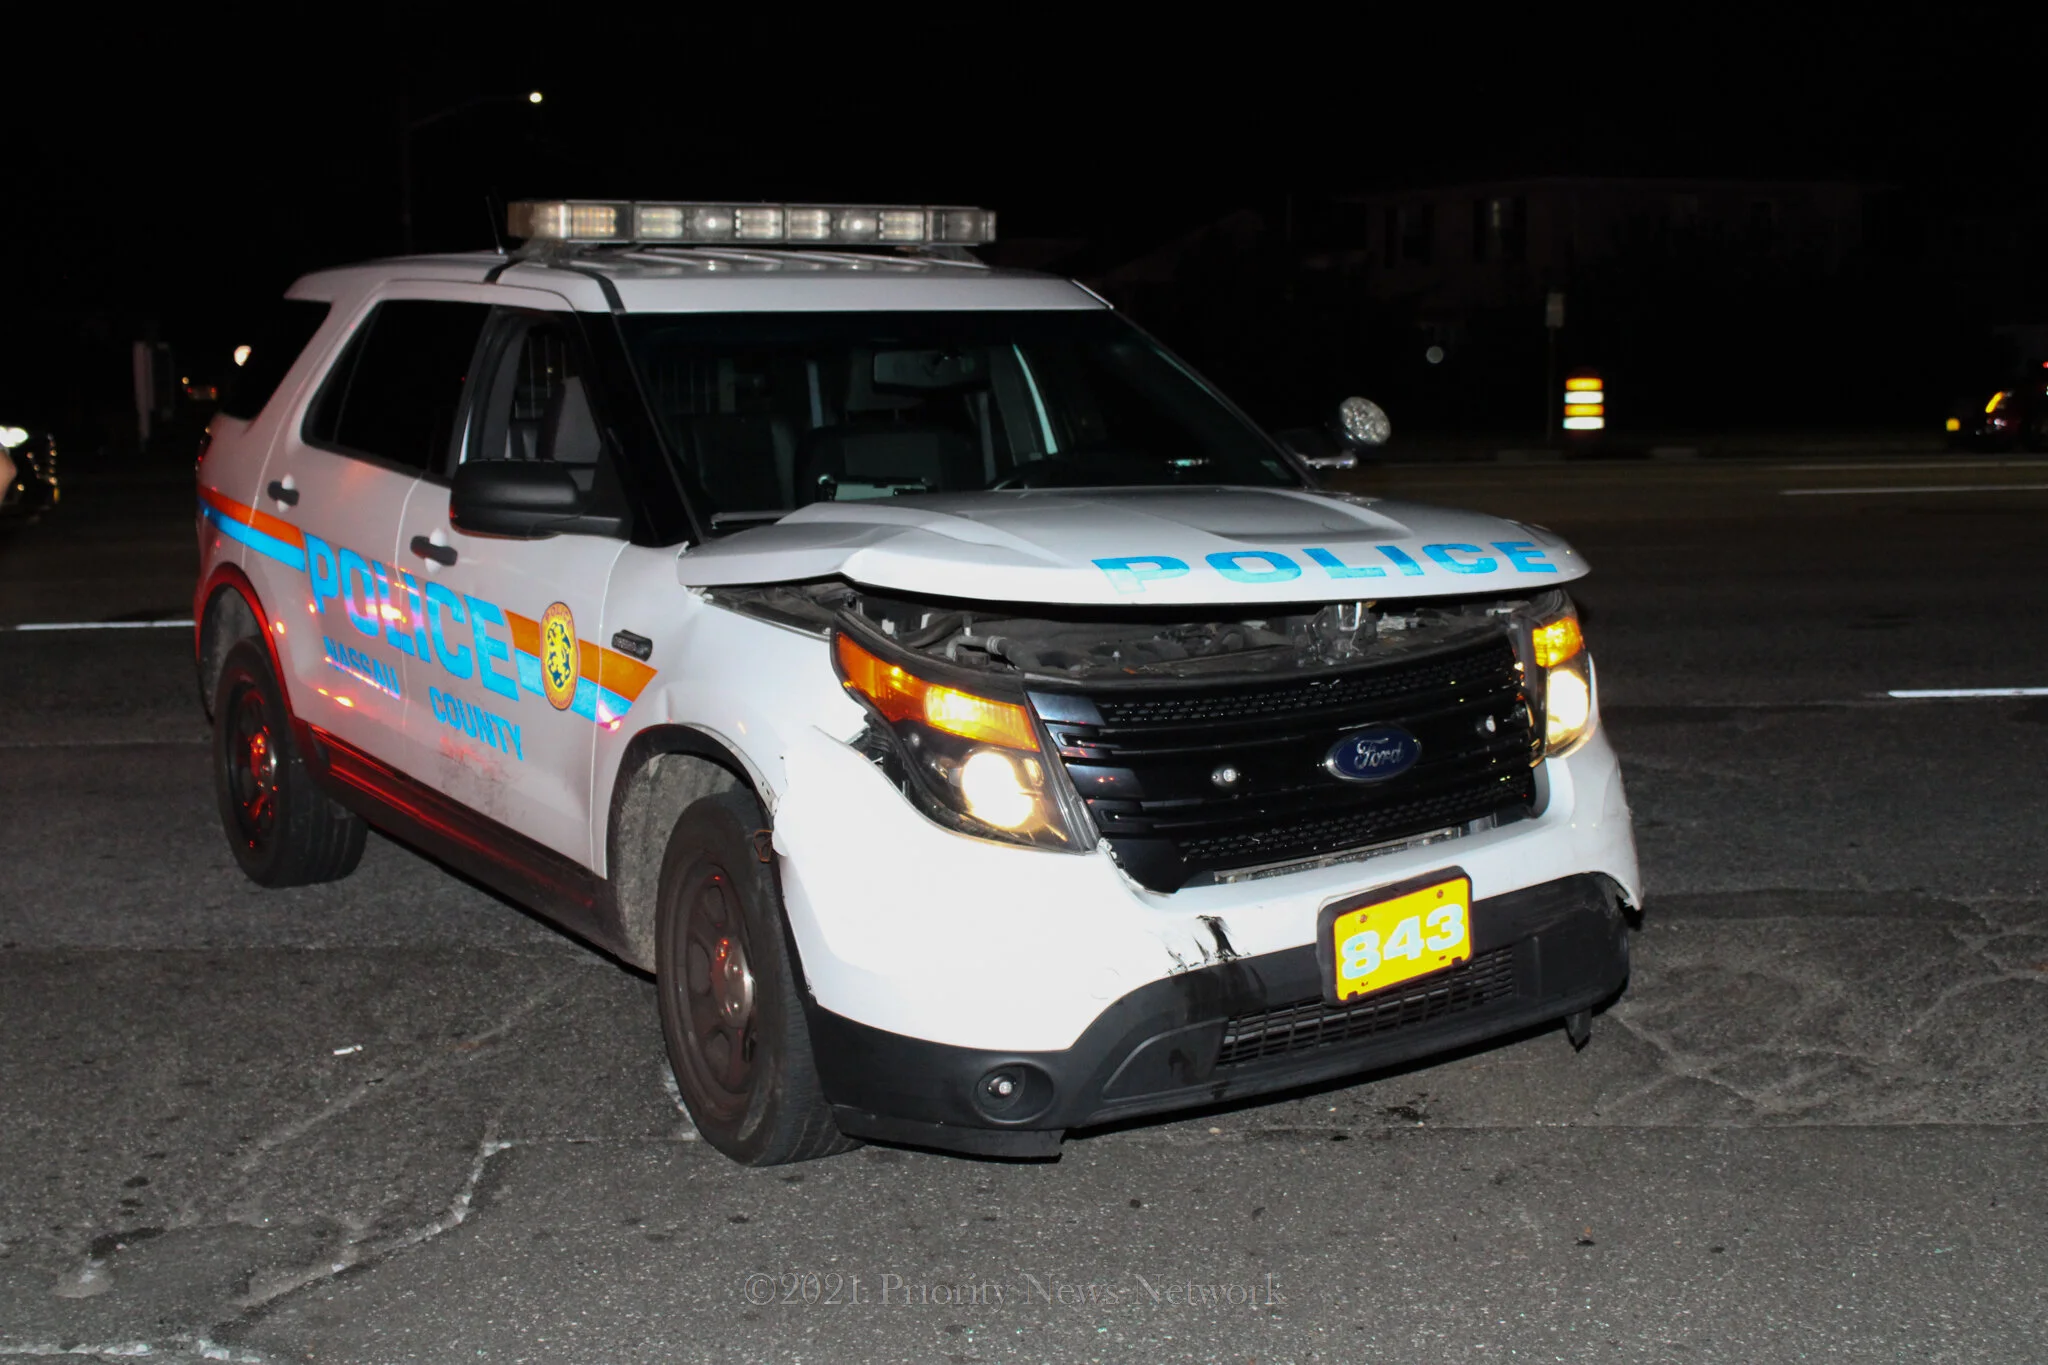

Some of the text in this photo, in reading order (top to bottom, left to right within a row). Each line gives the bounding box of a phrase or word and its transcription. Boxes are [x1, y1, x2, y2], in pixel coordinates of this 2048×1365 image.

[1092, 541, 1558, 594] POLICE
[303, 532, 519, 701] POLICE
[323, 636, 524, 760] NASSAU COUNTY
[1354, 737, 1404, 769] Ford
[1341, 903, 1465, 980] 843
